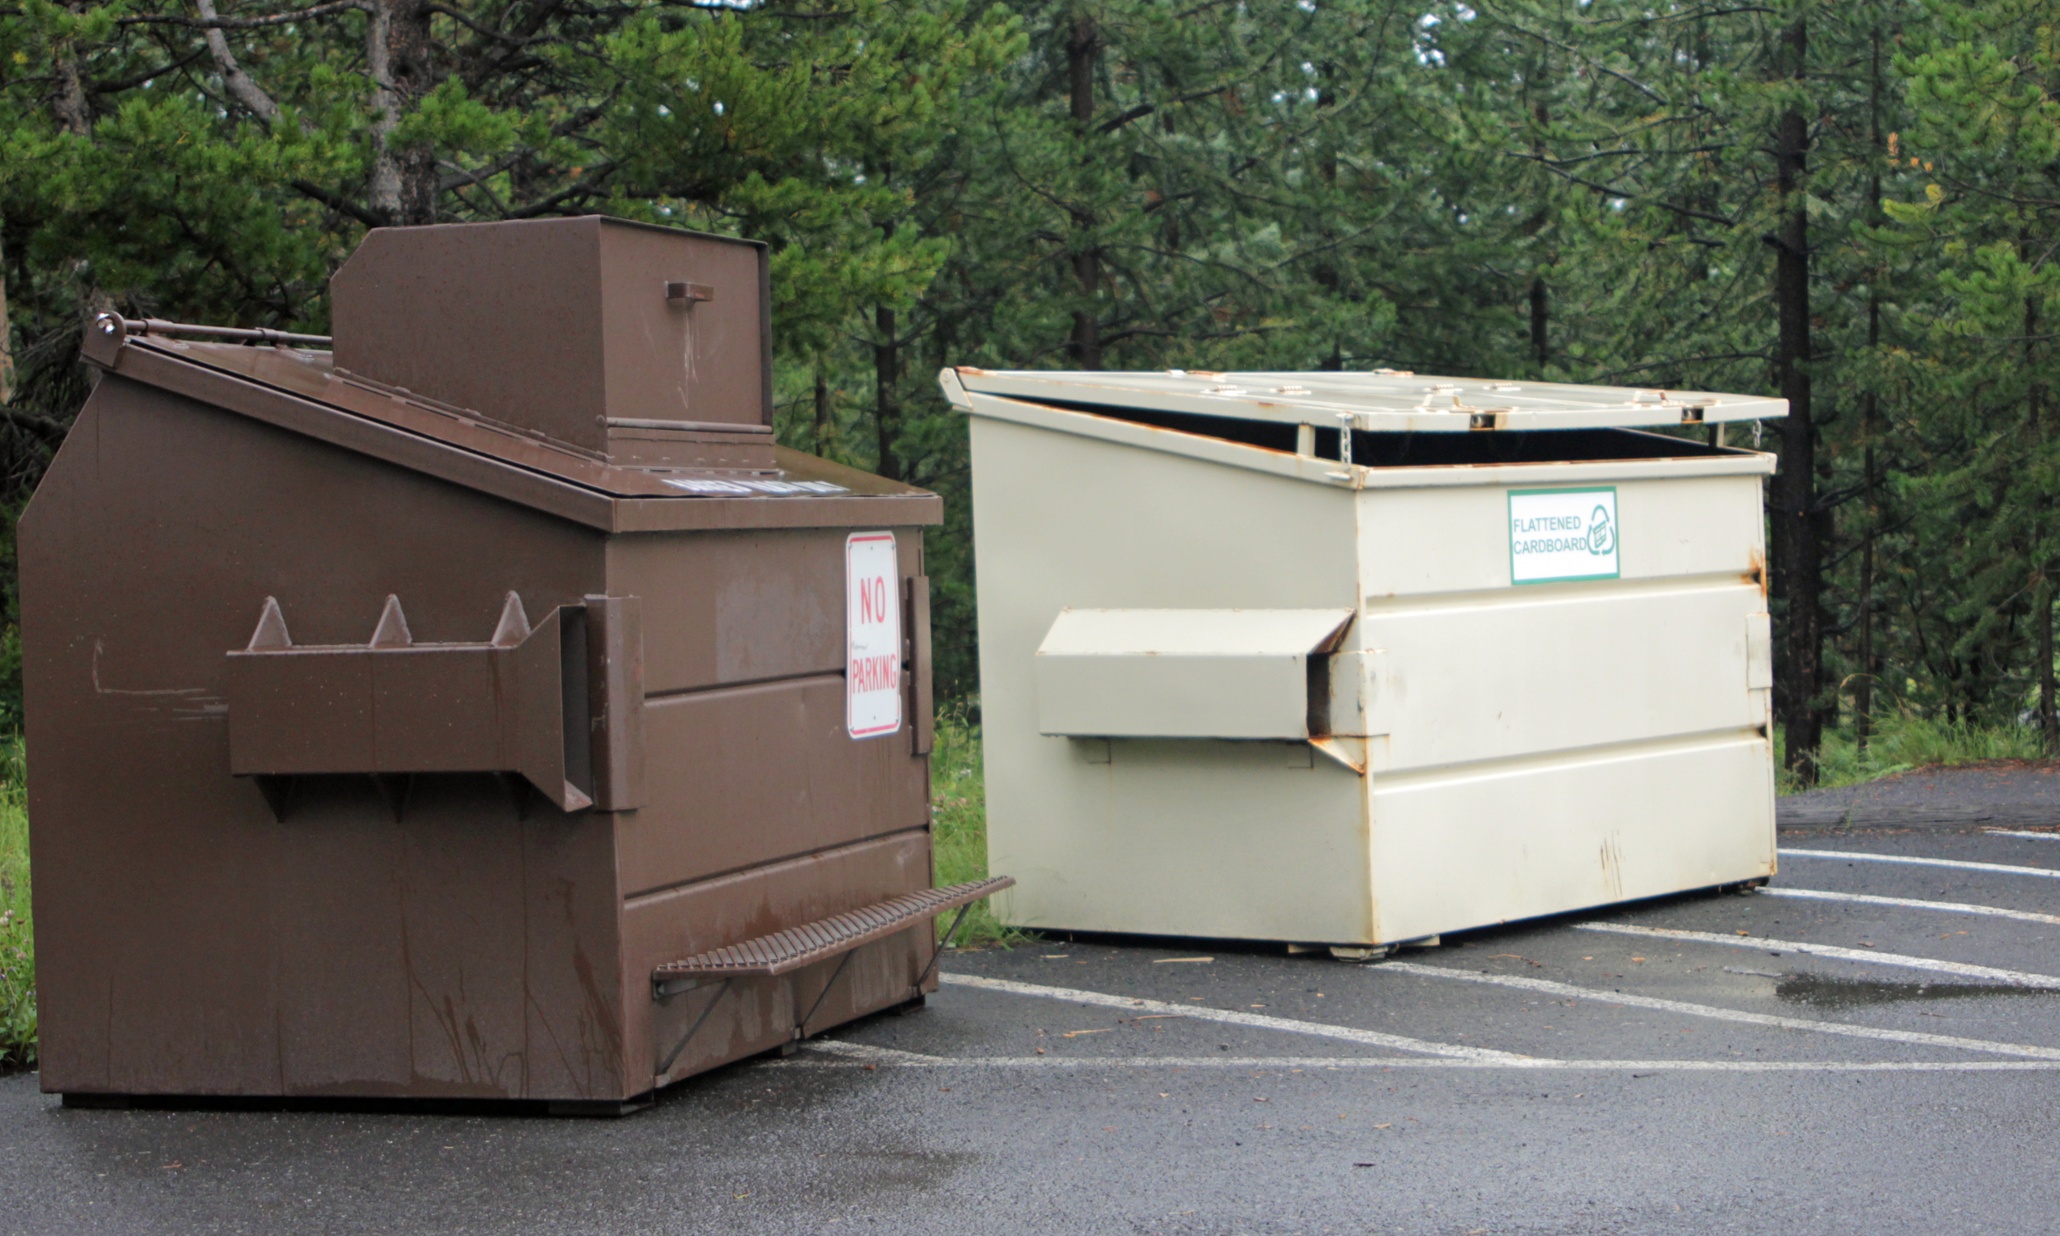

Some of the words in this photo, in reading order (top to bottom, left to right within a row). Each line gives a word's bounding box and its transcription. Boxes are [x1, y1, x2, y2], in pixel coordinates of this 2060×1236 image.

[1513, 516, 1581, 533] FLATTENED
[1513, 537, 1587, 555] CARDBOARD
[860, 575, 886, 624] NO
[852, 653, 897, 693] PARKING
